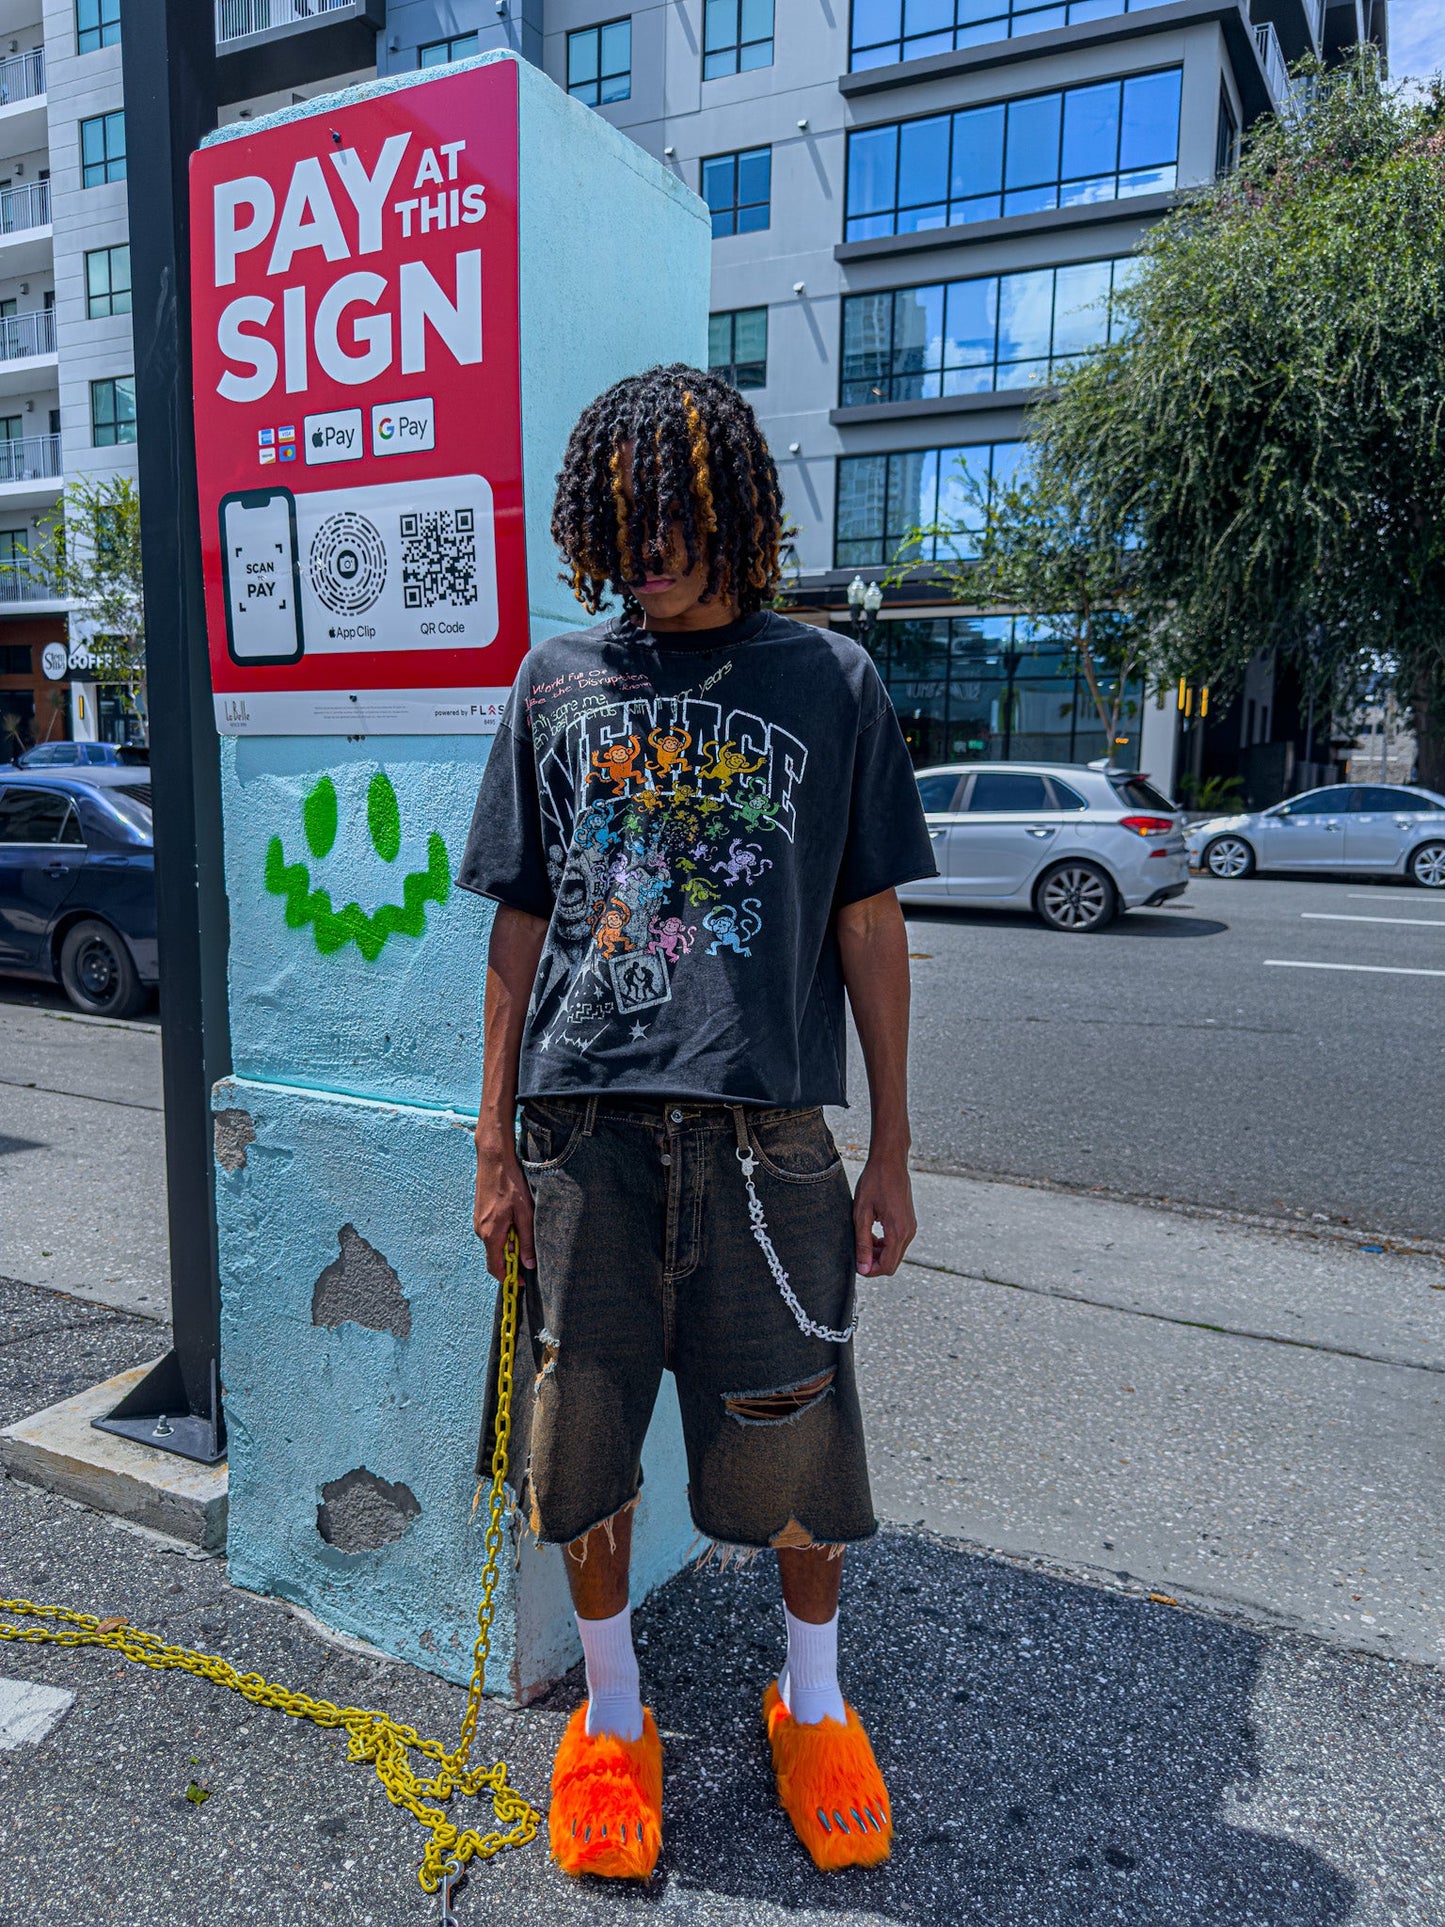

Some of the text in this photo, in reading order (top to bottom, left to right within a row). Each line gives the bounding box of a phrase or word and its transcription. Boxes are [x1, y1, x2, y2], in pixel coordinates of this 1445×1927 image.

[213, 131, 467, 288] PAY AT
[394, 184, 487, 238] THIS
[216, 248, 483, 403] SIGN
[325, 426, 355, 449] Pay
[399, 416, 428, 440] Pay
[246, 561, 275, 574] SCAN
[247, 581, 276, 598] PAY
[336, 625, 376, 640] App Clip
[420, 621, 465, 635] QR Code
[531, 674, 565, 696] World
[568, 671, 584, 682] Full
[551, 685, 573, 699] the
[578, 672, 649, 689] Disruption
[699, 660, 733, 699] years
[434, 709, 460, 717] powered
[460, 709, 468, 717] by
[551, 701, 579, 721] scare
[538, 696, 808, 853] MENACE
